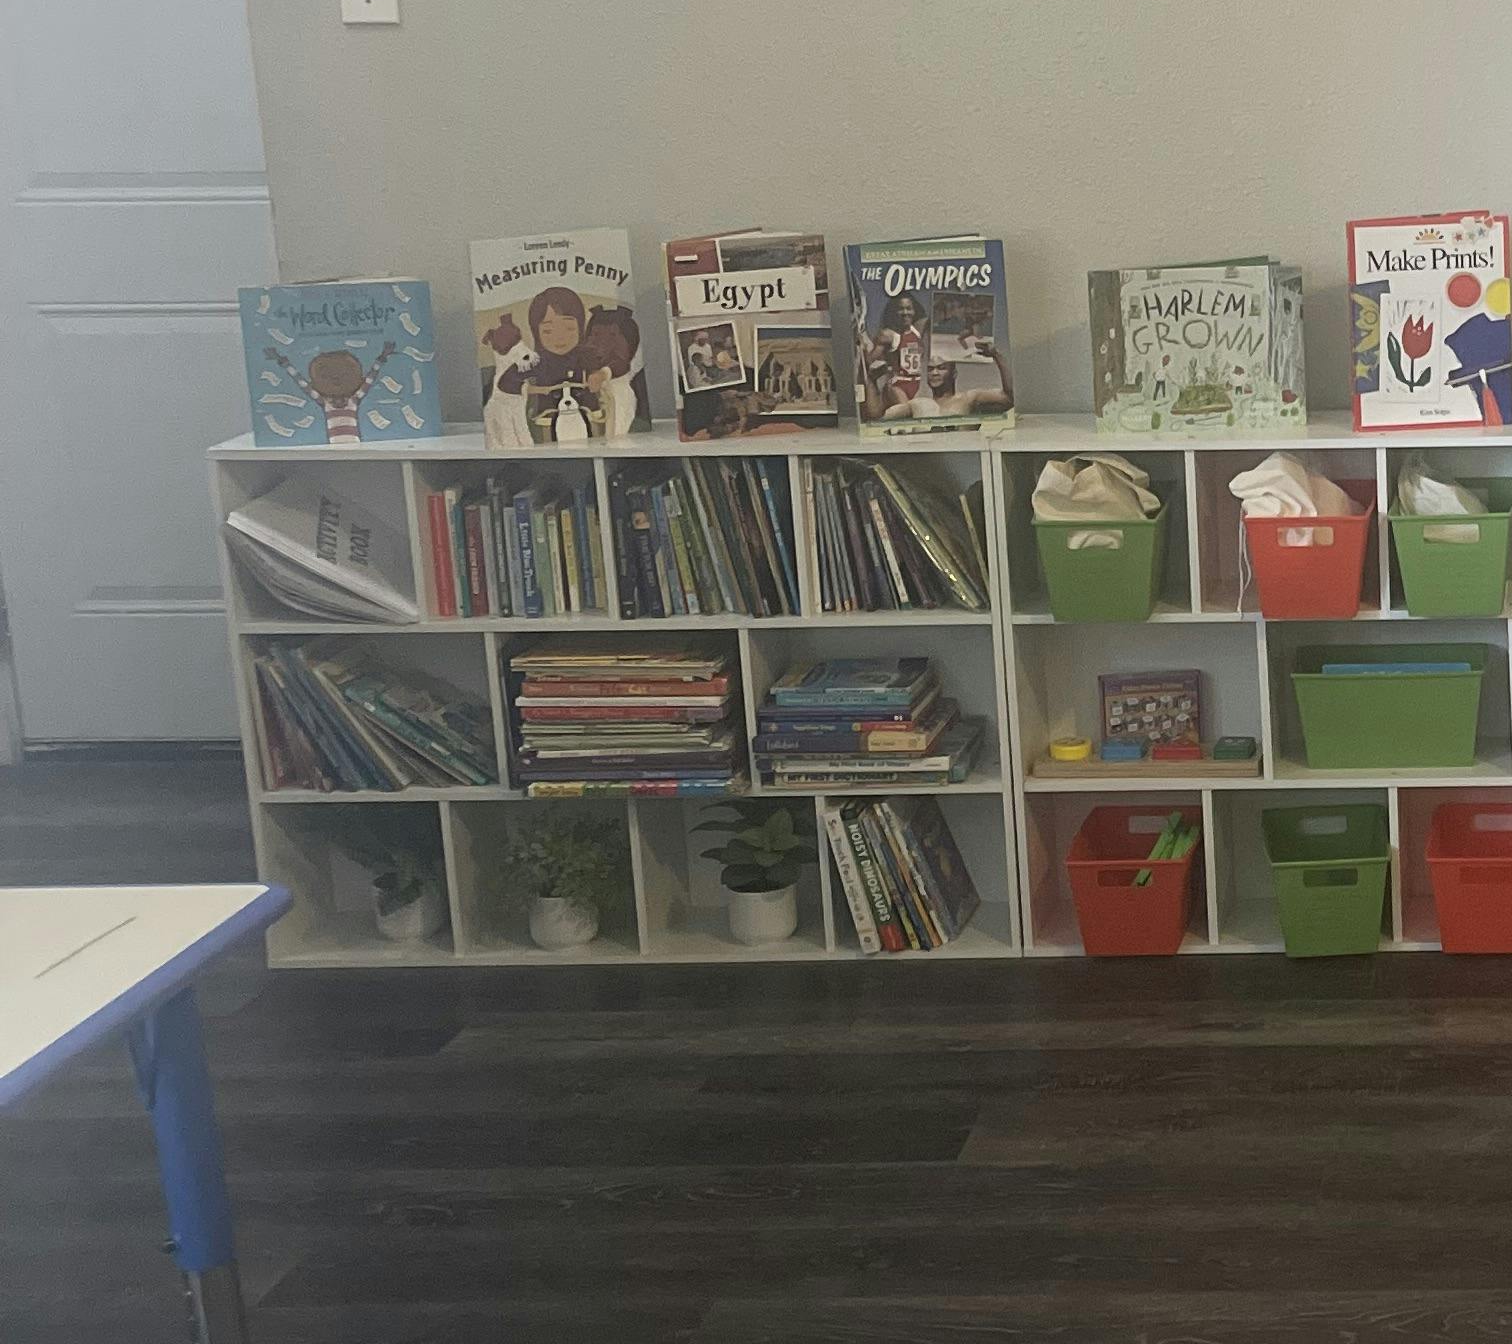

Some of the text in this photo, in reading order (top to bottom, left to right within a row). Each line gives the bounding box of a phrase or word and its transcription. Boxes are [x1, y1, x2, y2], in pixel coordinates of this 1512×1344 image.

[474, 255, 629, 294] Measuring Penny
[1367, 245, 1495, 273] Make Prints!
[702, 278, 786, 311] Egypt
[861, 263, 992, 297] THE OLYMPICS
[1143, 288, 1246, 322] HARLEM
[1132, 319, 1265, 357] GROWN
[317, 496, 341, 564] ACTIVITY
[350, 523, 371, 567] BOOK
[848, 824, 868, 857] NOISY
[861, 859, 891, 922] DINOSAURS
